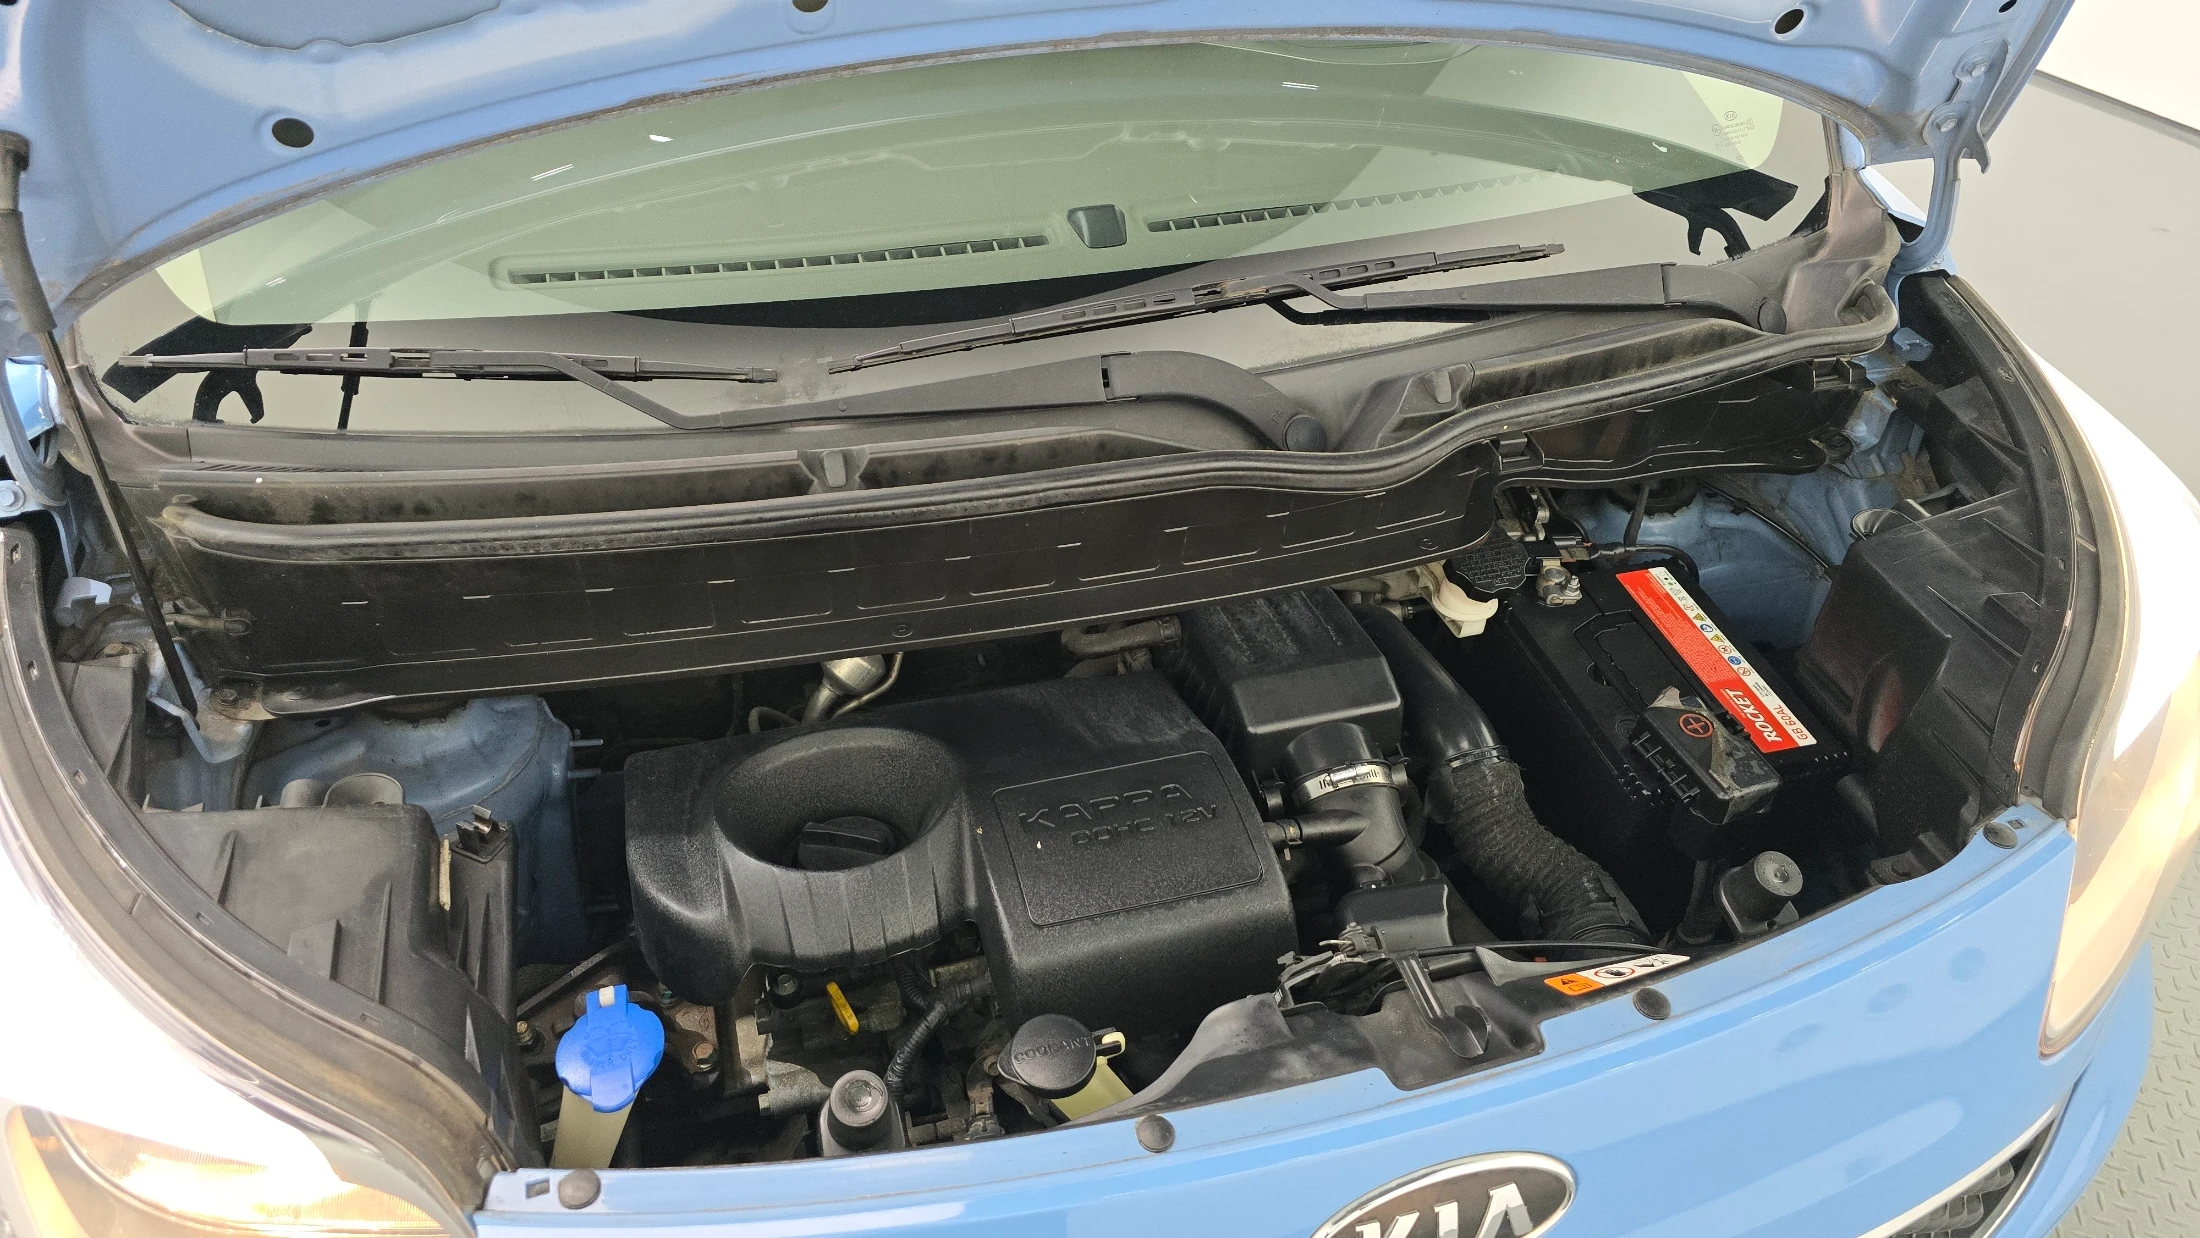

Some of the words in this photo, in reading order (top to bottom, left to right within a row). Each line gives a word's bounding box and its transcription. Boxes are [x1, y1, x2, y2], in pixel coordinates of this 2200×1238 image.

[1725, 688, 1783, 742] ROCKET
[1792, 728, 1808, 740] GB
[1018, 783, 1193, 833] KAPPA
[1071, 818, 1154, 845] DOHC
[1164, 804, 1216, 827] 12V
[1013, 1036, 1091, 1065] COOLANT
